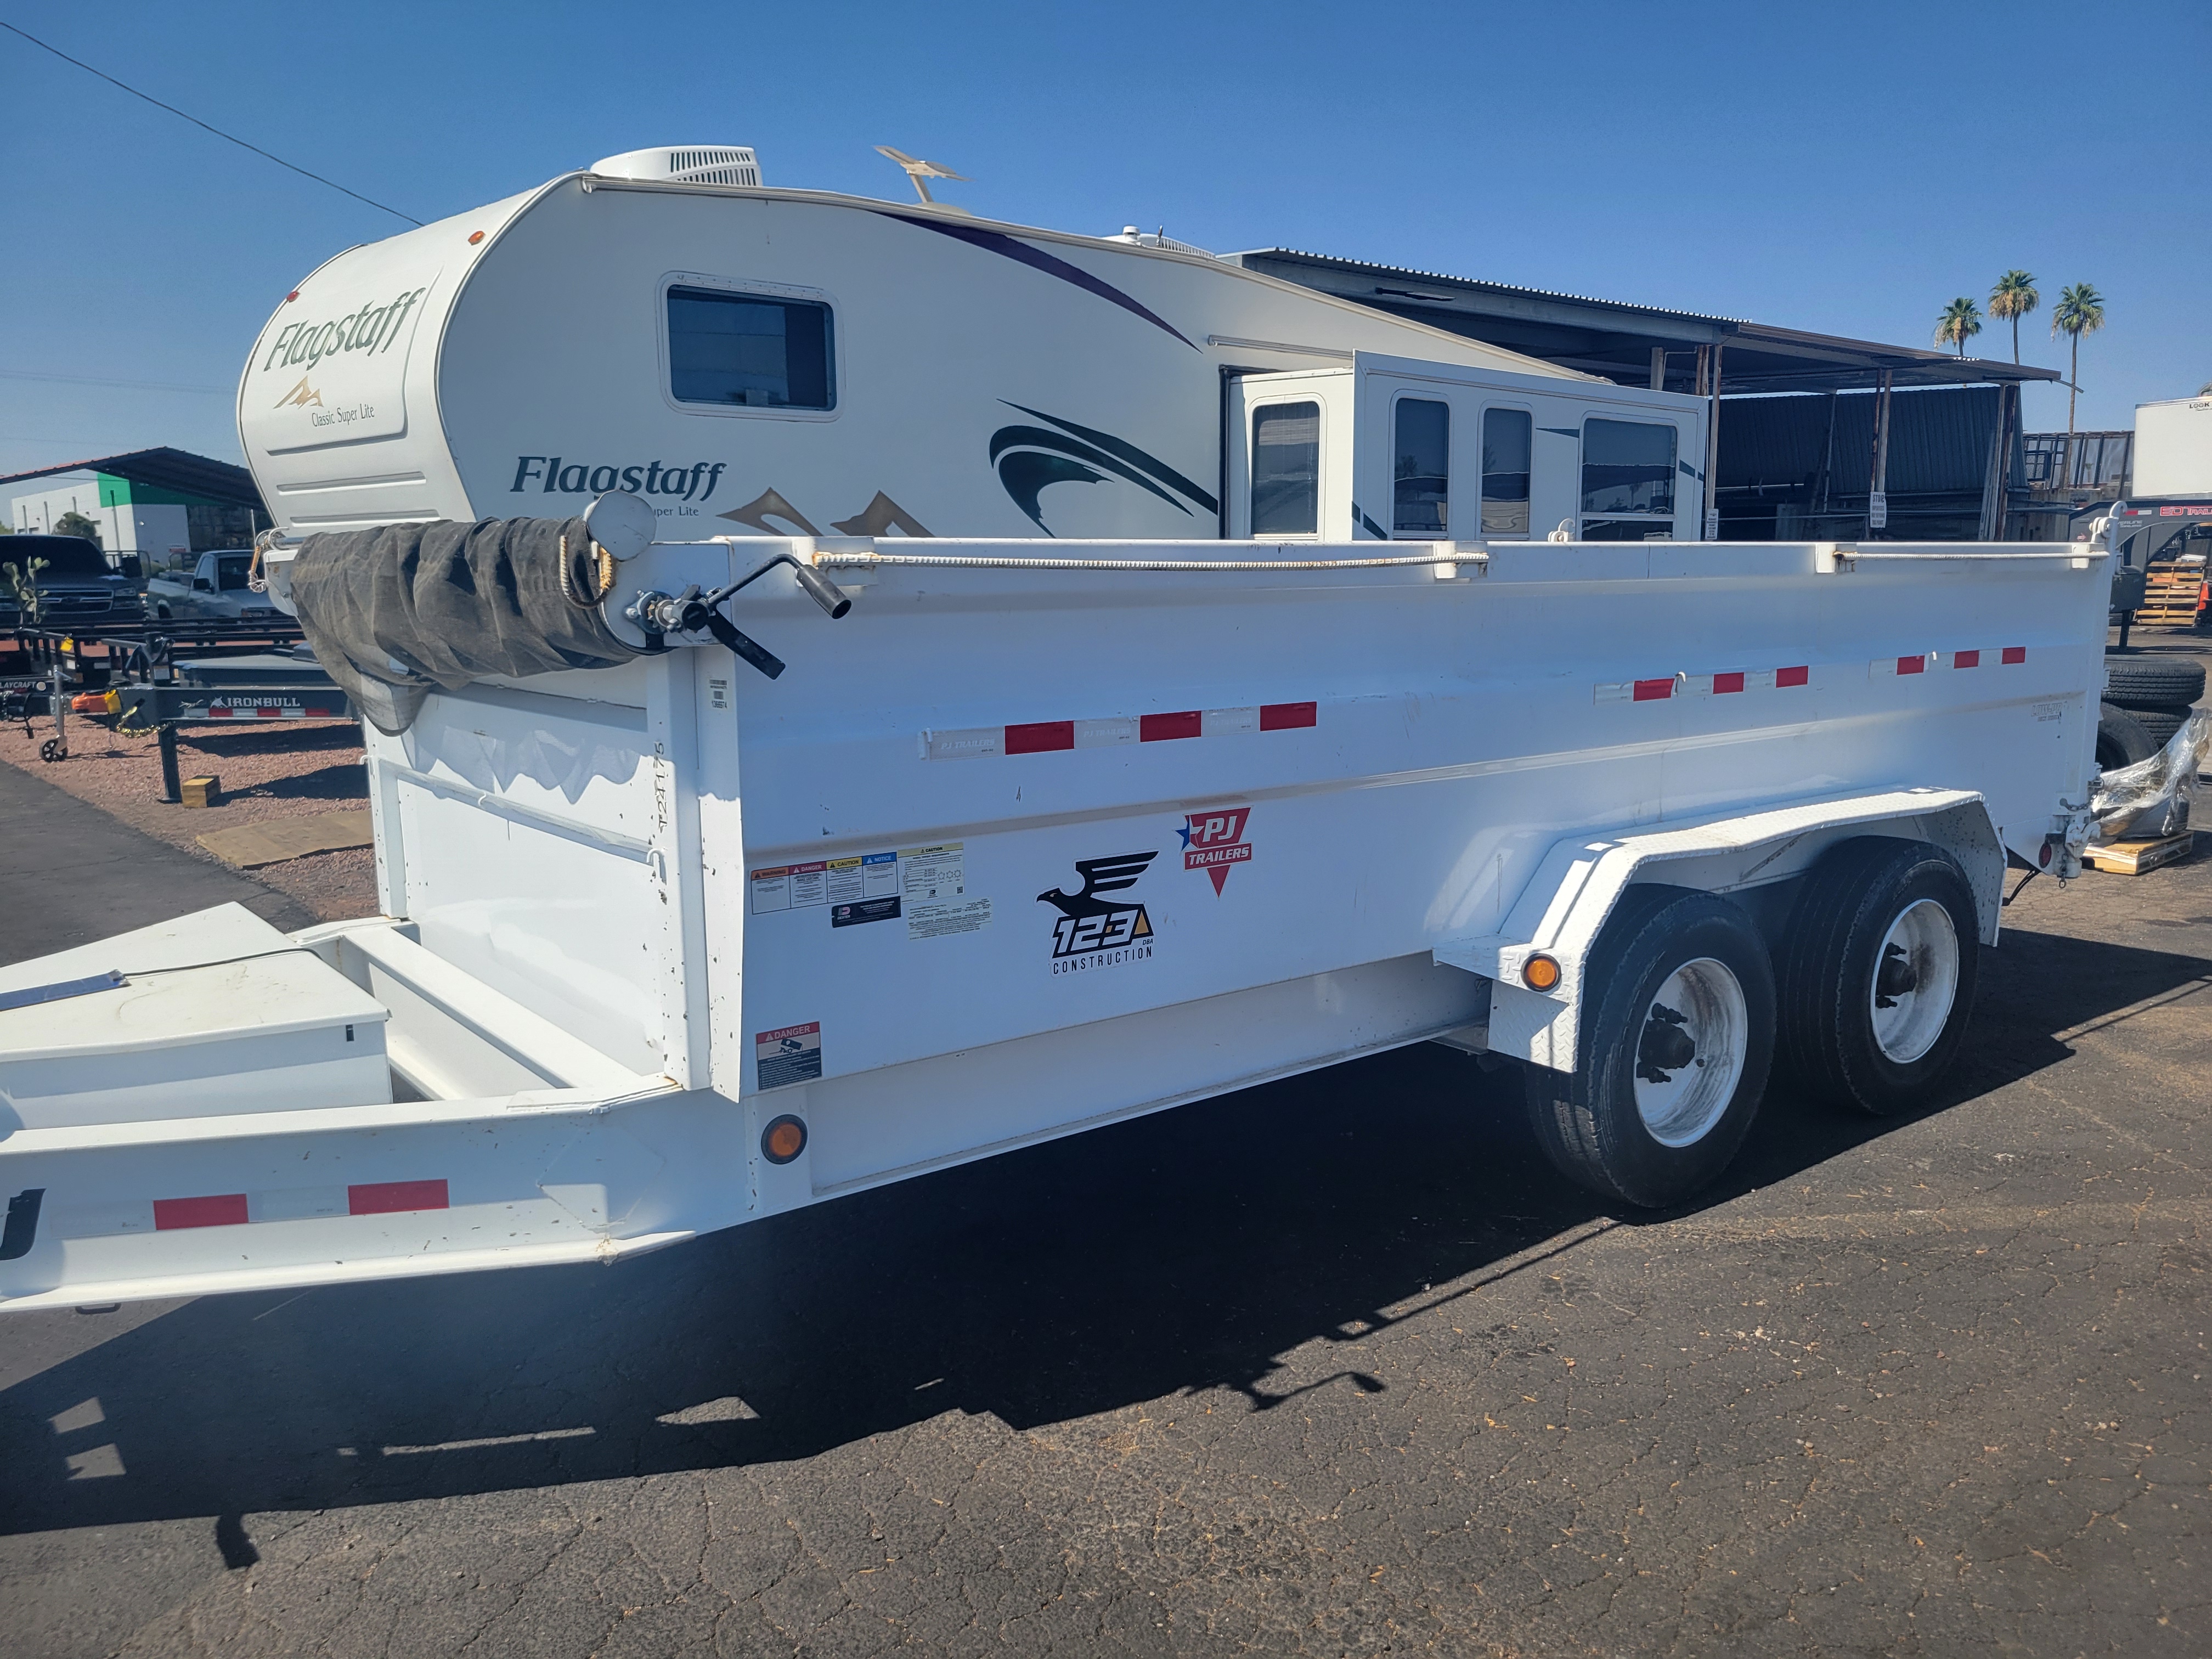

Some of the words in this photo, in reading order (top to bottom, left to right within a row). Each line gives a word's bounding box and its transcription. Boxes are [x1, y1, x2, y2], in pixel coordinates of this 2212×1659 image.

[263, 287, 426, 372] Flagstaff
[312, 410, 335, 427] Classic
[337, 407, 357, 425] Super
[360, 403, 375, 419] Lite
[510, 456, 727, 501] Flagstaff
[1872, 494, 1884, 503] STOP
[679, 506, 699, 516] Lite
[2183, 505, 2212, 516] TRAIL
[227, 697, 301, 707] IRONBULL
[955, 739, 995, 748] TRAILERS
[1202, 816, 1238, 843] PJ
[1189, 847, 1250, 865] TRAILERS
[1053, 946, 1153, 975] CONSTRUCTION
[774, 1025, 810, 1039] DANGER
